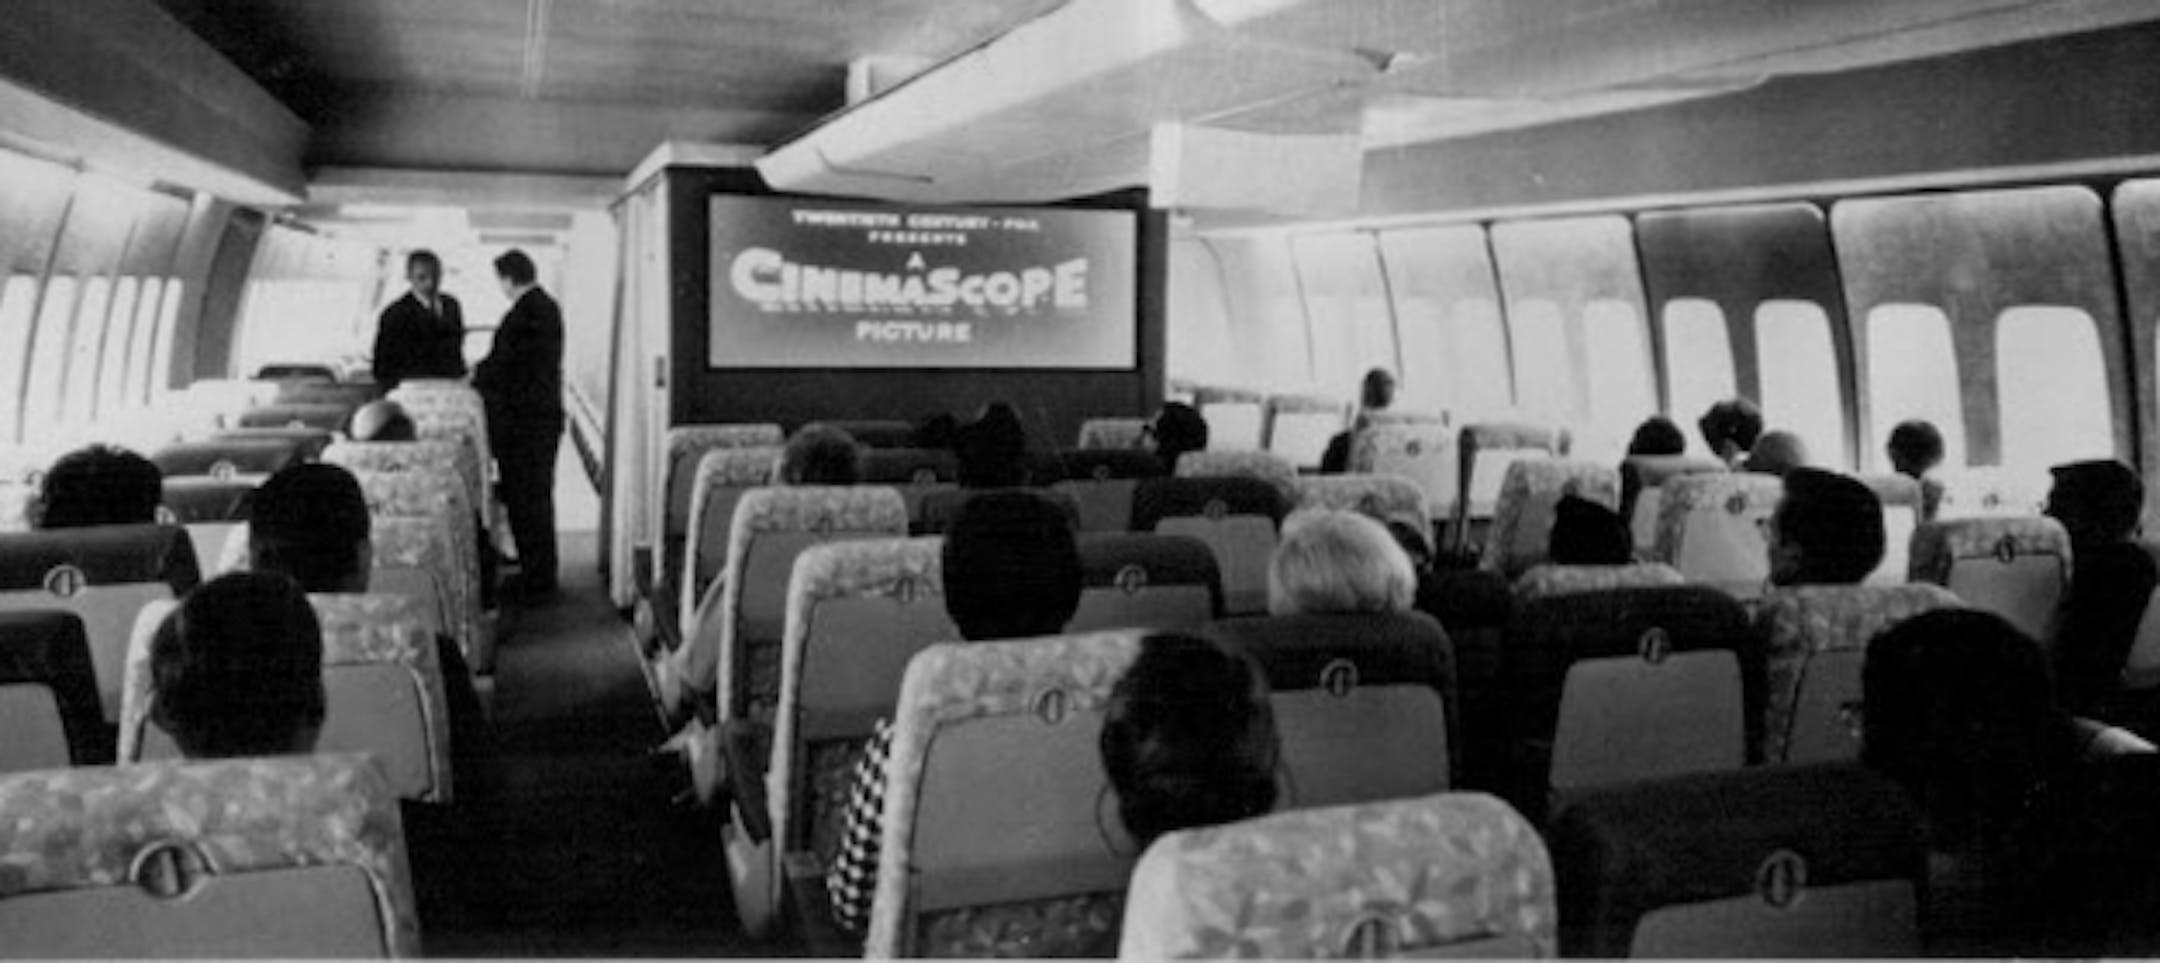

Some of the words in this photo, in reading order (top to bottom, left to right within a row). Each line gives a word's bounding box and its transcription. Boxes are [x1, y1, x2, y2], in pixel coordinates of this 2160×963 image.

[868, 230, 967, 246] PRESENTS
[907, 251, 926, 269] A
[856, 321, 972, 342] PICTURE
